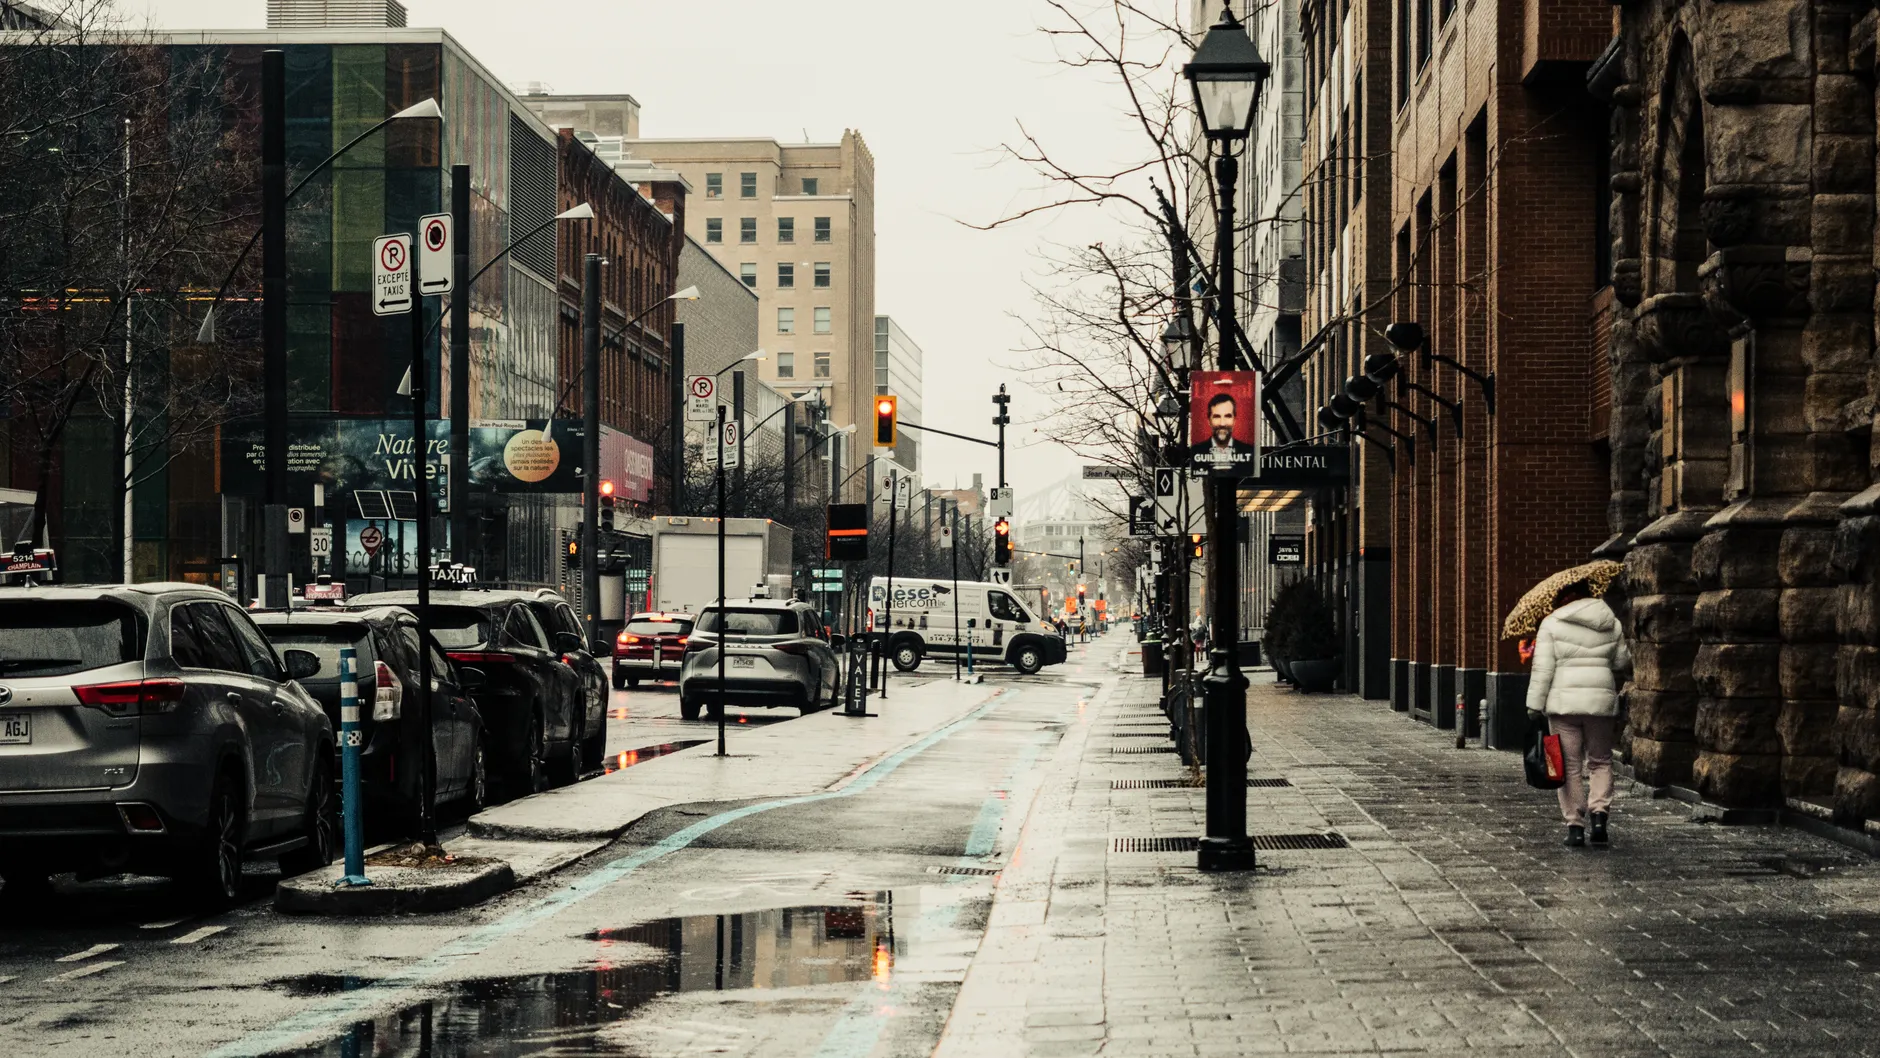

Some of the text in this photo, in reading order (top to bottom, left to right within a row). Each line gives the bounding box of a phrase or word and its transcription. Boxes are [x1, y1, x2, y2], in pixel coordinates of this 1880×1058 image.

[377, 269, 409, 285] EXCEPTÉ
[383, 284, 404, 296] TAXIS
[375, 433, 448, 455] Natre
[1193, 453, 1252, 462] GUILBEAULT
[313, 537, 328, 552] 30
[12, 554, 34, 563] 5214
[7, 562, 42, 571] CHAMPLAIN
[429, 569, 460, 581] TAXI
[881, 598, 937, 609] Itercom
[853, 654, 863, 709] VALET
[5, 720, 29, 737] AGJ
